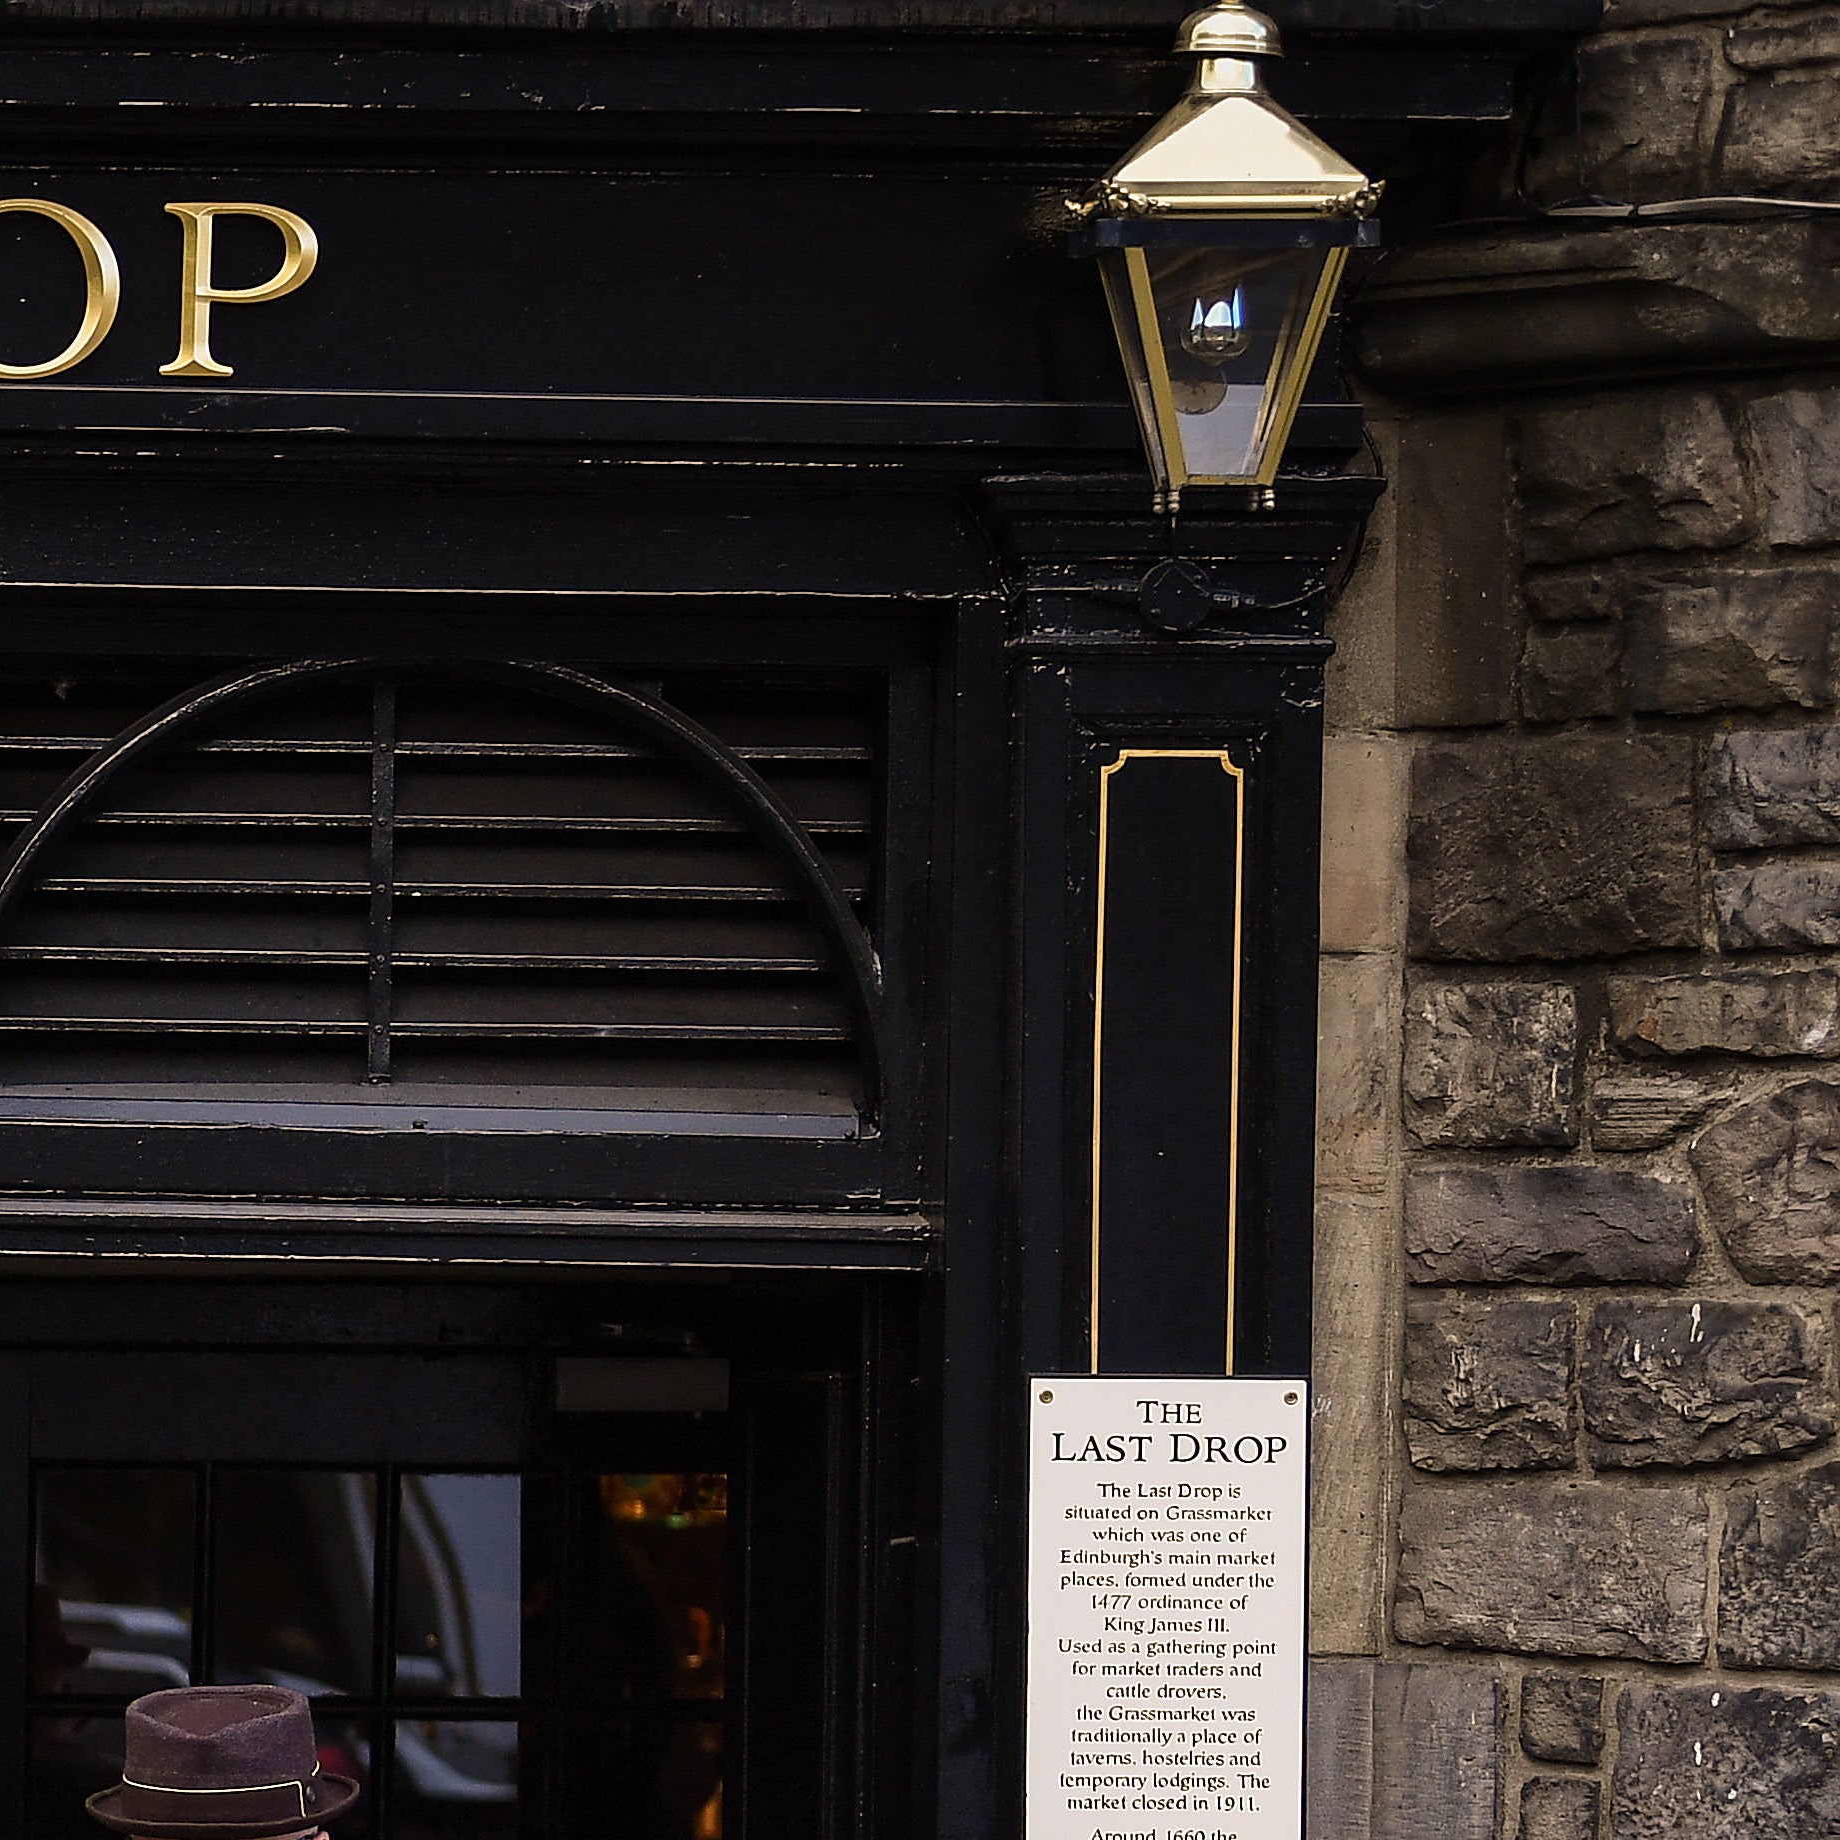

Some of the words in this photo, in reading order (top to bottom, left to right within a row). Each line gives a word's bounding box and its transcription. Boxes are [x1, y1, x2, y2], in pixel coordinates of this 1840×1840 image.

[1136, 1401, 1202, 1424] THE
[1051, 1433, 1152, 1462] LAST
[1169, 1434, 1287, 1463] DROP
[1097, 1483, 1130, 1498] The
[1138, 1484, 1171, 1497] Last
[1178, 1483, 1222, 1501] Drop
[1229, 1483, 1240, 1498] is
[1065, 1505, 1131, 1519] situated
[1137, 1510, 1158, 1520] on
[1166, 1506, 1271, 1520] Grassmarket
[1092, 1527, 1143, 1542] which
[1151, 1531, 1184, 1542] was
[1190, 1532, 1221, 1542] one
[1229, 1528, 1247, 1543] of
[1060, 1549, 1162, 1568] Edinburgh's
[1169, 1551, 1210, 1564] main
[1217, 1551, 1275, 1565] market
[1126, 1572, 1186, 1587] formed
[1193, 1573, 1244, 1587] under
[1249, 1573, 1274, 1588] the
[1092, 1594, 1131, 1609] 1477
[1138, 1595, 1223, 1609] ordinance
[1230, 1595, 1248, 1610] of
[1105, 1617, 1145, 1635] King
[1147, 1618, 1202, 1634] James
[1208, 1618, 1229, 1632] III.
[1059, 1639, 1102, 1653] Used
[1108, 1643, 1125, 1653] as
[1132, 1643, 1140, 1653] a
[1147, 1639, 1227, 1658] gathering
[1233, 1640, 1275, 1659] point
[1073, 1661, 1096, 1675] for
[1102, 1661, 1160, 1676] market
[1167, 1662, 1224, 1676] traders
[1230, 1662, 1261, 1677] and
[1107, 1683, 1150, 1698] cattle
[1077, 1705, 1102, 1720] the
[1109, 1706, 1215, 1721] Grassmarket
[1222, 1710, 1255, 1721] was
[1072, 1728, 1172, 1747] traditionally
[1177, 1733, 1185, 1742] a
[1192, 1728, 1236, 1747] place
[1244, 1729, 1262, 1744] of
[1143, 1750, 1224, 1766] hostelries
[1229, 1751, 1260, 1767] and
[1060, 1773, 1147, 1792] temporary
[1154, 1772, 1229, 1792] lodgings.
[1237, 1774, 1269, 1788] The
[1068, 1794, 1126, 1810] market
[1132, 1794, 1186, 1810] closed
[1193, 1795, 1208, 1811] in
[1217, 1796, 1259, 1811] 1911.
